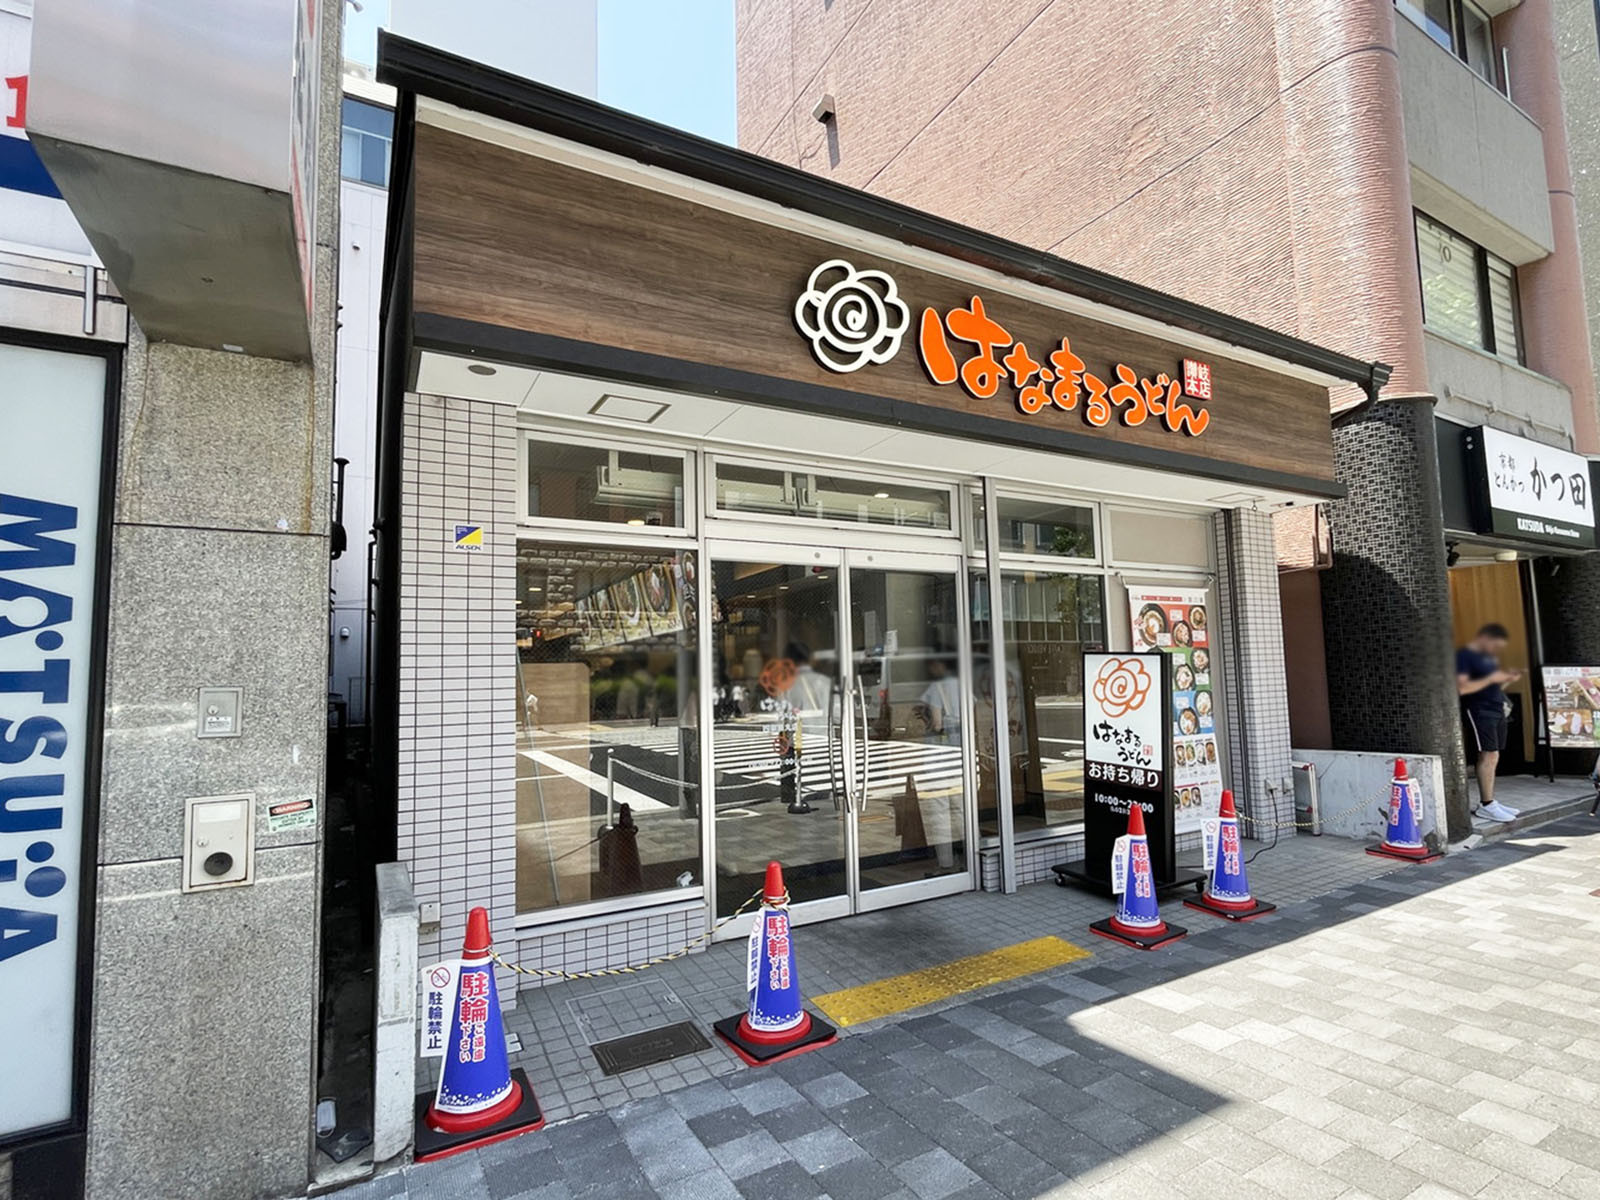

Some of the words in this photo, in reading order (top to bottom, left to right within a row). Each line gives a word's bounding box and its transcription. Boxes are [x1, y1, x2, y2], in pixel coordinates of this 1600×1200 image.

[920, 295, 1209, 437] はなまるうどん
[1494, 471, 1525, 493] とんかつ
[1529, 457, 1586, 510] かつ田
[1093, 719, 1141, 747] はなまる
[1088, 762, 1159, 788] お持ち帰り
[1117, 746, 1152, 767] うどん
[459, 973, 489, 1024] 駐輪
[427, 991, 443, 1050] 駐輪禁止
